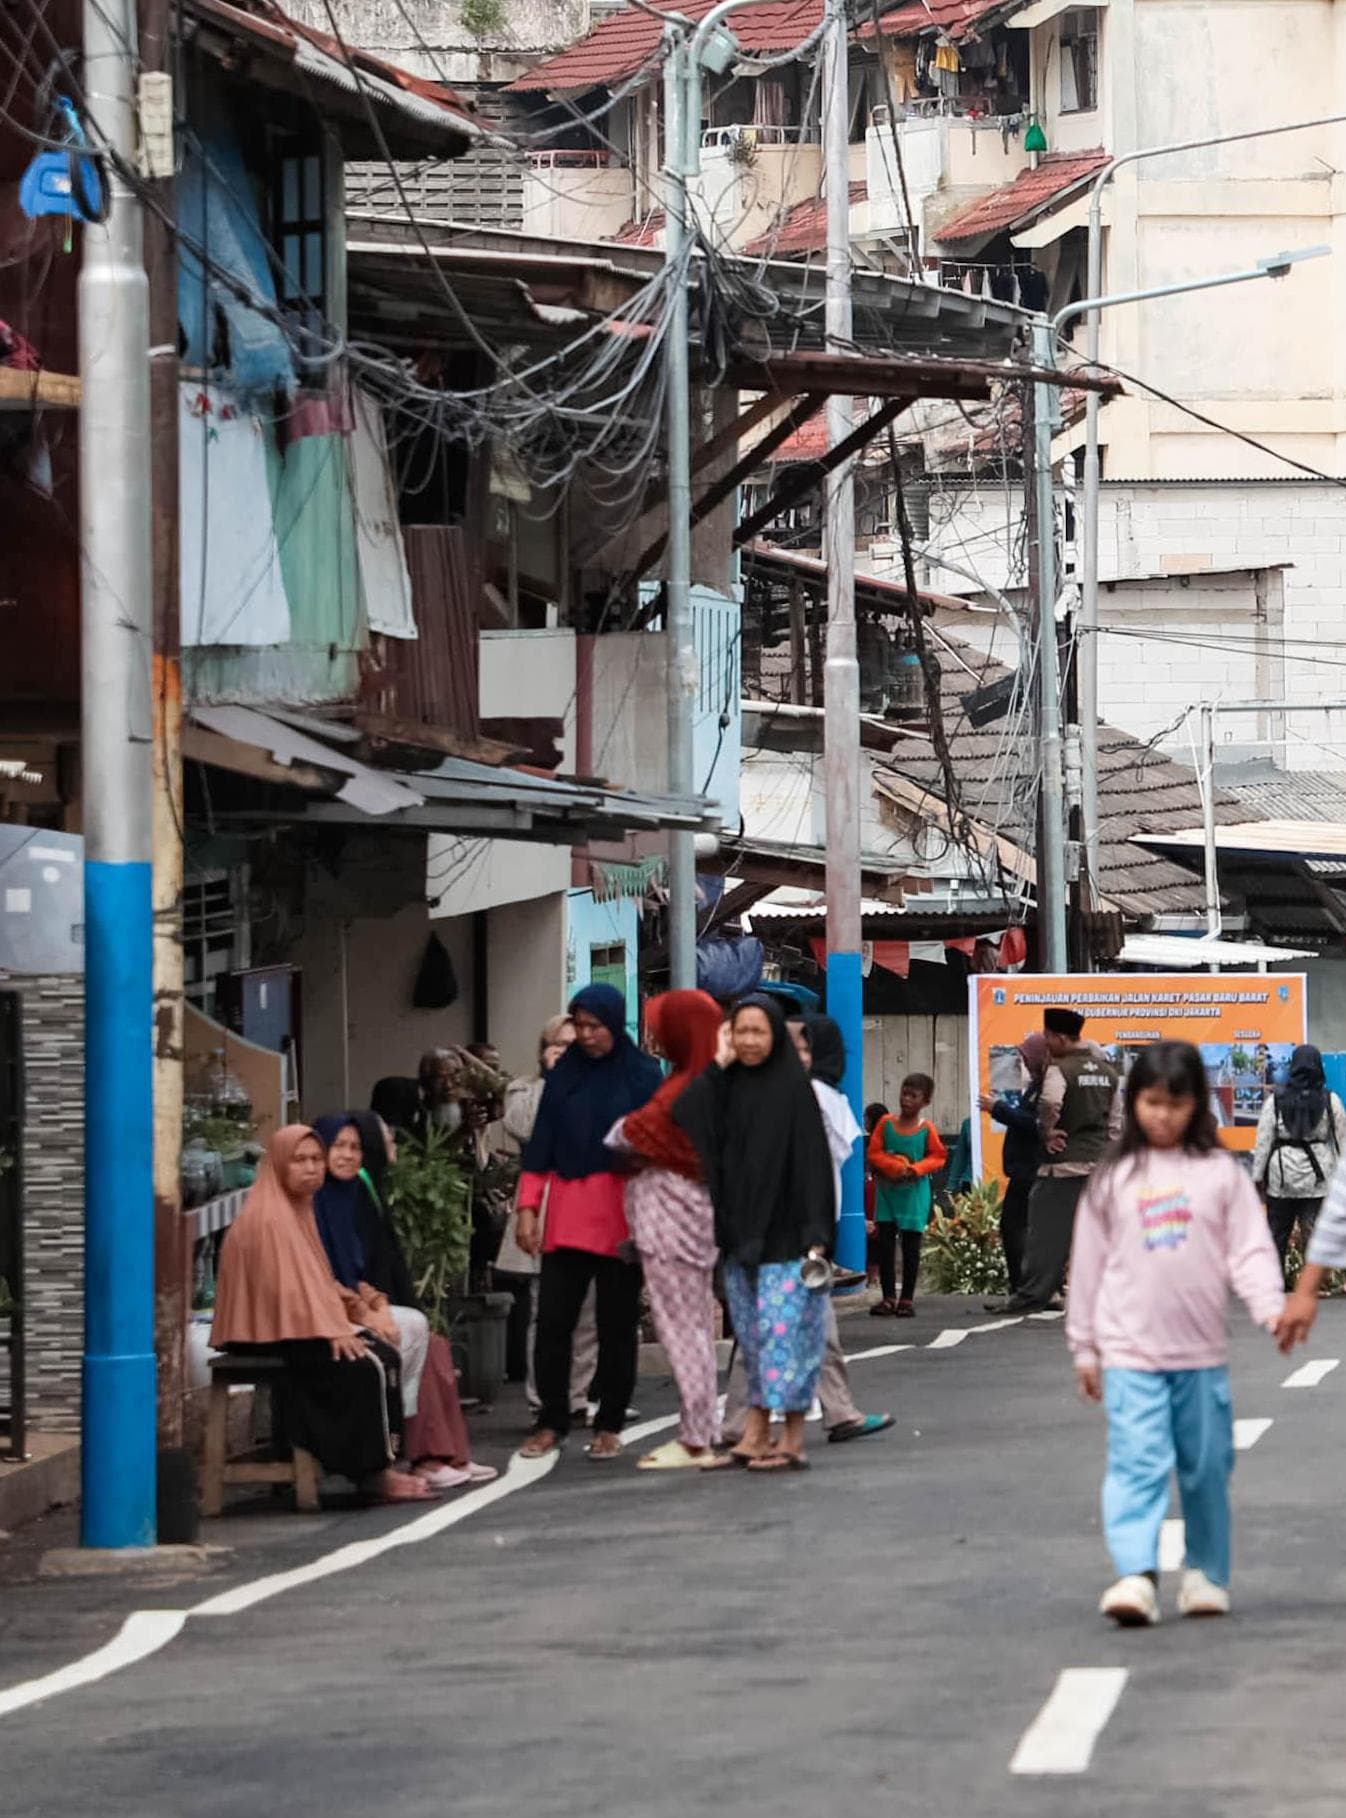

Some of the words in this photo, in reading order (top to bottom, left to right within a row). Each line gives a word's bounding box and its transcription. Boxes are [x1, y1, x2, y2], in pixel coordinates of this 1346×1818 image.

[1014, 993, 1069, 1004] PENINJAUAN
[1070, 993, 1120, 1004] PERBAIKAN
[1121, 993, 1150, 1004] JALAN
[1151, 993, 1181, 1004] KARET
[1182, 993, 1212, 1003] PASAR
[1213, 993, 1238, 1003] BARU
[1238, 992, 1269, 1003] BARAT
[1085, 1007, 1129, 1018] GUBERNUR
[1129, 1007, 1167, 1018] PROVINSI
[1168, 1007, 1183, 1018] DKI
[1183, 1007, 1221, 1017] JAKARTA
